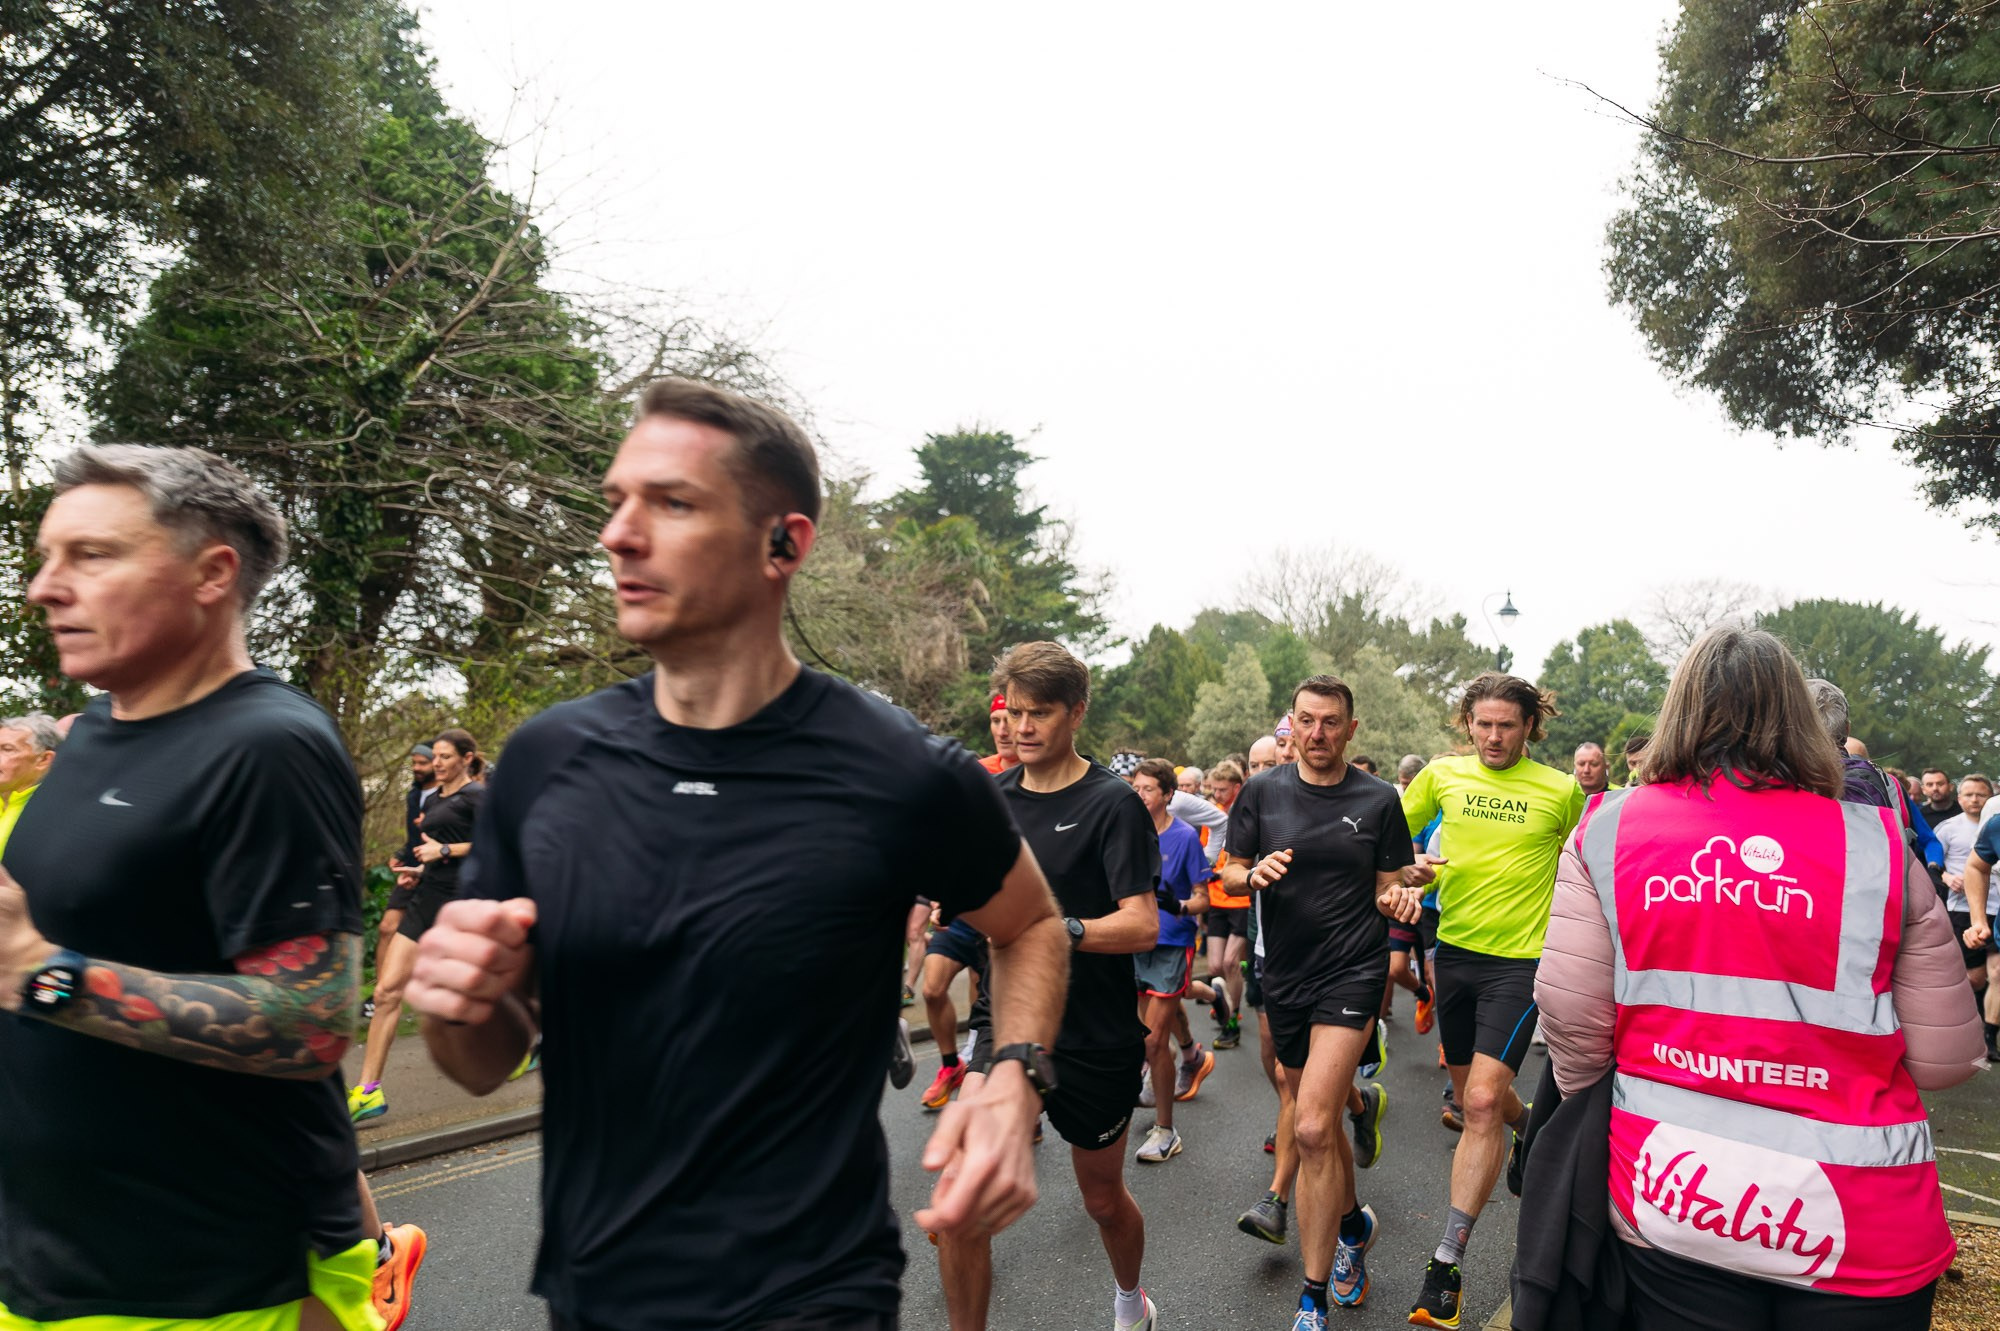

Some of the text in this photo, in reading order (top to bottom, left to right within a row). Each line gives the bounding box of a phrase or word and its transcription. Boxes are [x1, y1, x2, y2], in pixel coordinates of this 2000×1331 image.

[1462, 807, 1525, 824] RUNNERS
[1466, 793, 1528, 813] VEGAN
[1743, 844, 1781, 866] Vitality
[1644, 858, 1814, 919] parkrun
[1653, 1042, 1829, 1090] VOLUNTEER
[1641, 1151, 1834, 1276] Vitality
